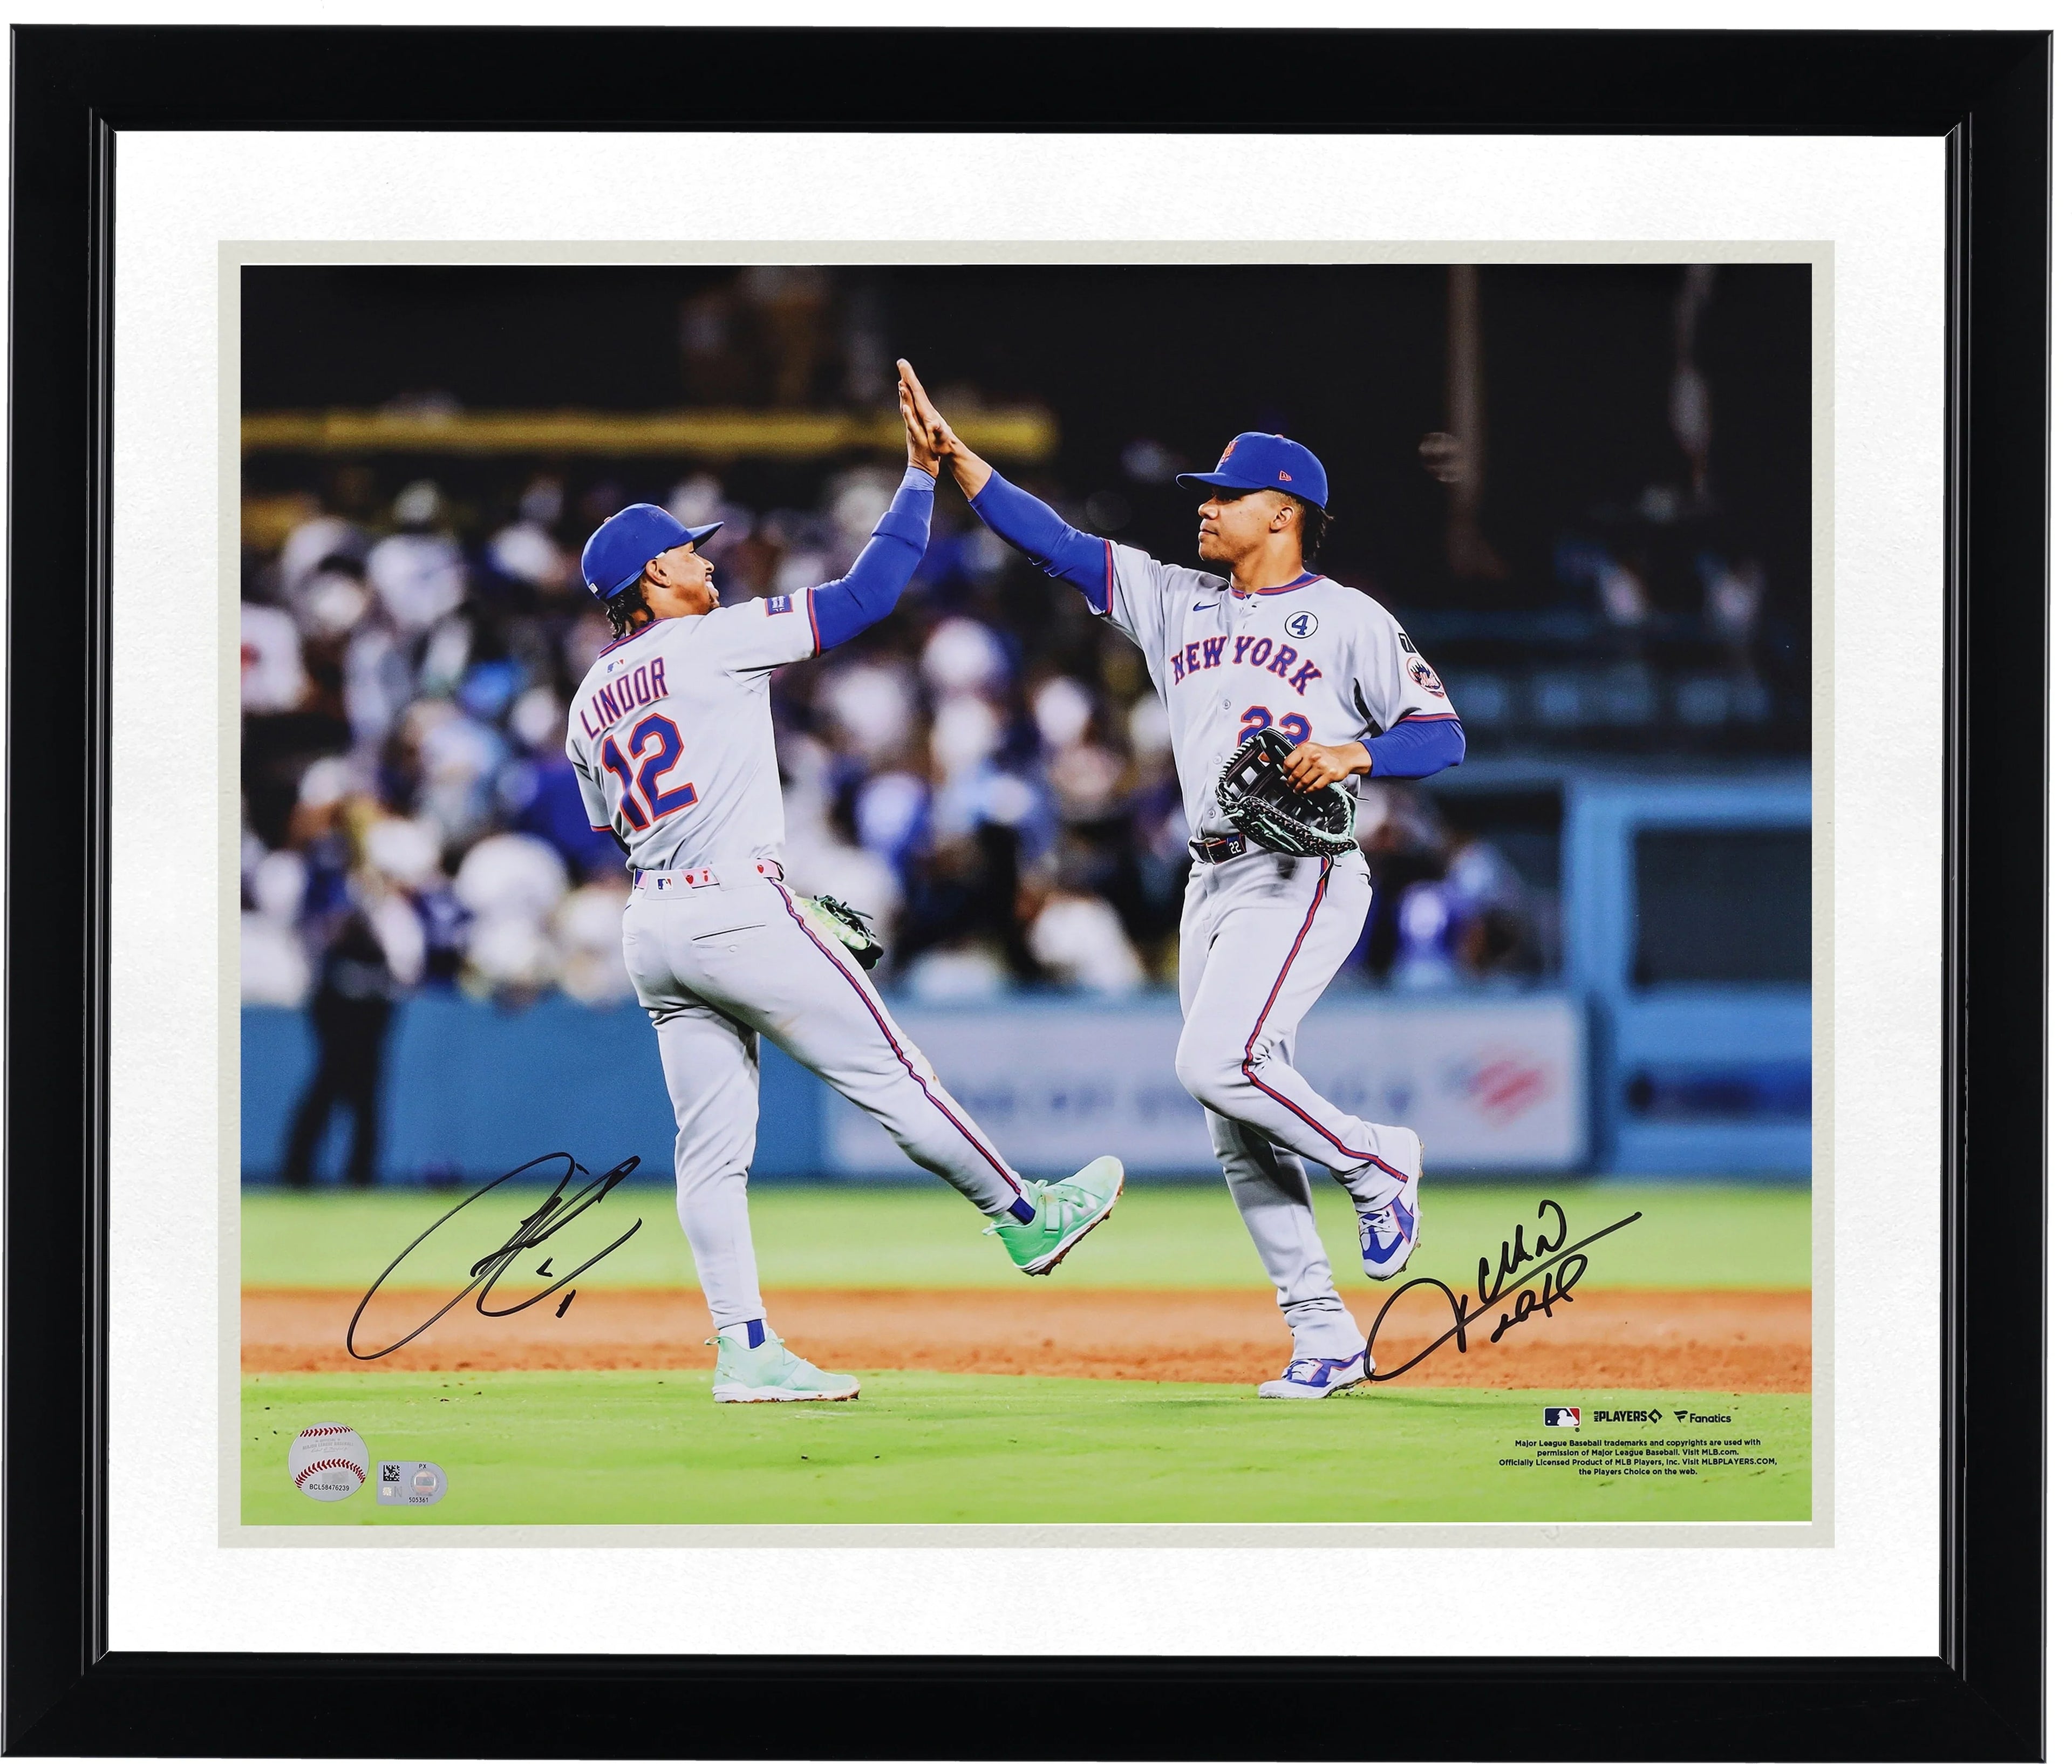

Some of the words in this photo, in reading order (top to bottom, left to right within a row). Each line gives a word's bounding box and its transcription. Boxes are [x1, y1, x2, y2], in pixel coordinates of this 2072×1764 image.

[1291, 614, 1308, 636] 4
[1170, 636, 1227, 686] NEW
[1232, 636, 1323, 696] YORK
[581, 656, 669, 741] LINDOR
[601, 713, 698, 832] 12
[1229, 841, 1242, 854] 22
[1599, 1411, 1647, 1422] PLAYERS
[1689, 1413, 1732, 1423] Fanatics
[1539, 1439, 1567, 1447] League
[1666, 1439, 1707, 1447] copyrights
[1537, 1449, 1579, 1457] permission
[1591, 1449, 1613, 1457] Major
[1615, 1449, 1644, 1457] League
[1499, 1459, 1533, 1467] Officially
[1634, 1459, 1664, 1467] Players,
[1701, 1457, 1777, 1466] MLBPLAYERS.COM,
[1594, 1468, 1622, 1476] Players
[309, 1483, 350, 1491] BCL58476239
